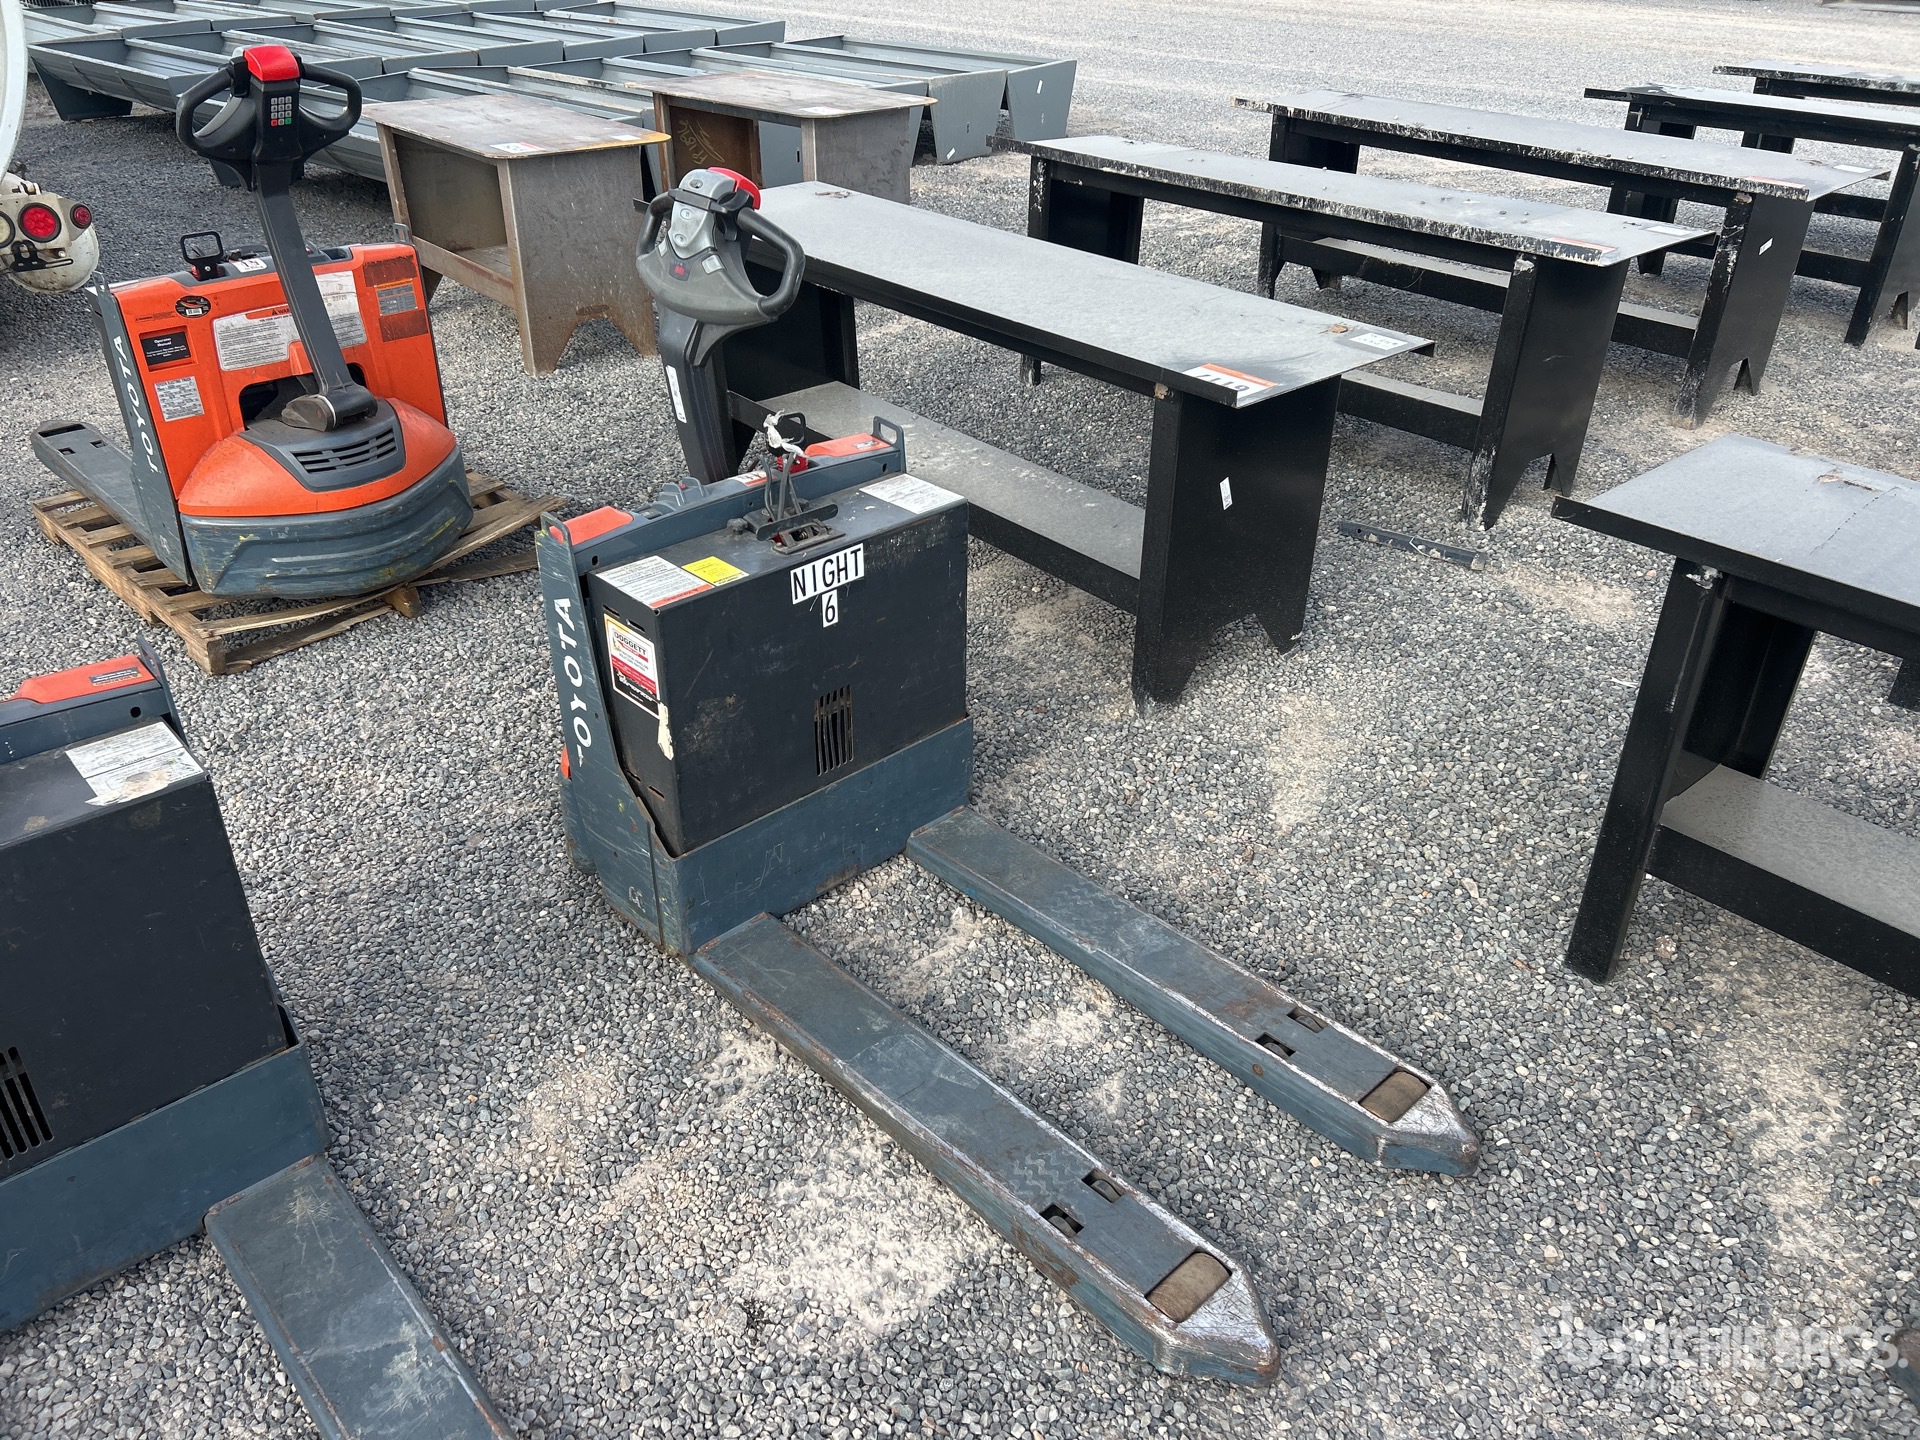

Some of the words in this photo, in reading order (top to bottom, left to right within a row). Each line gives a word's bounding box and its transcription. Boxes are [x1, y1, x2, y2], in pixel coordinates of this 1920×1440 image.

[113, 335, 159, 473] TOYOTA
[793, 548, 861, 601] NIGHT
[825, 594, 835, 623] 6
